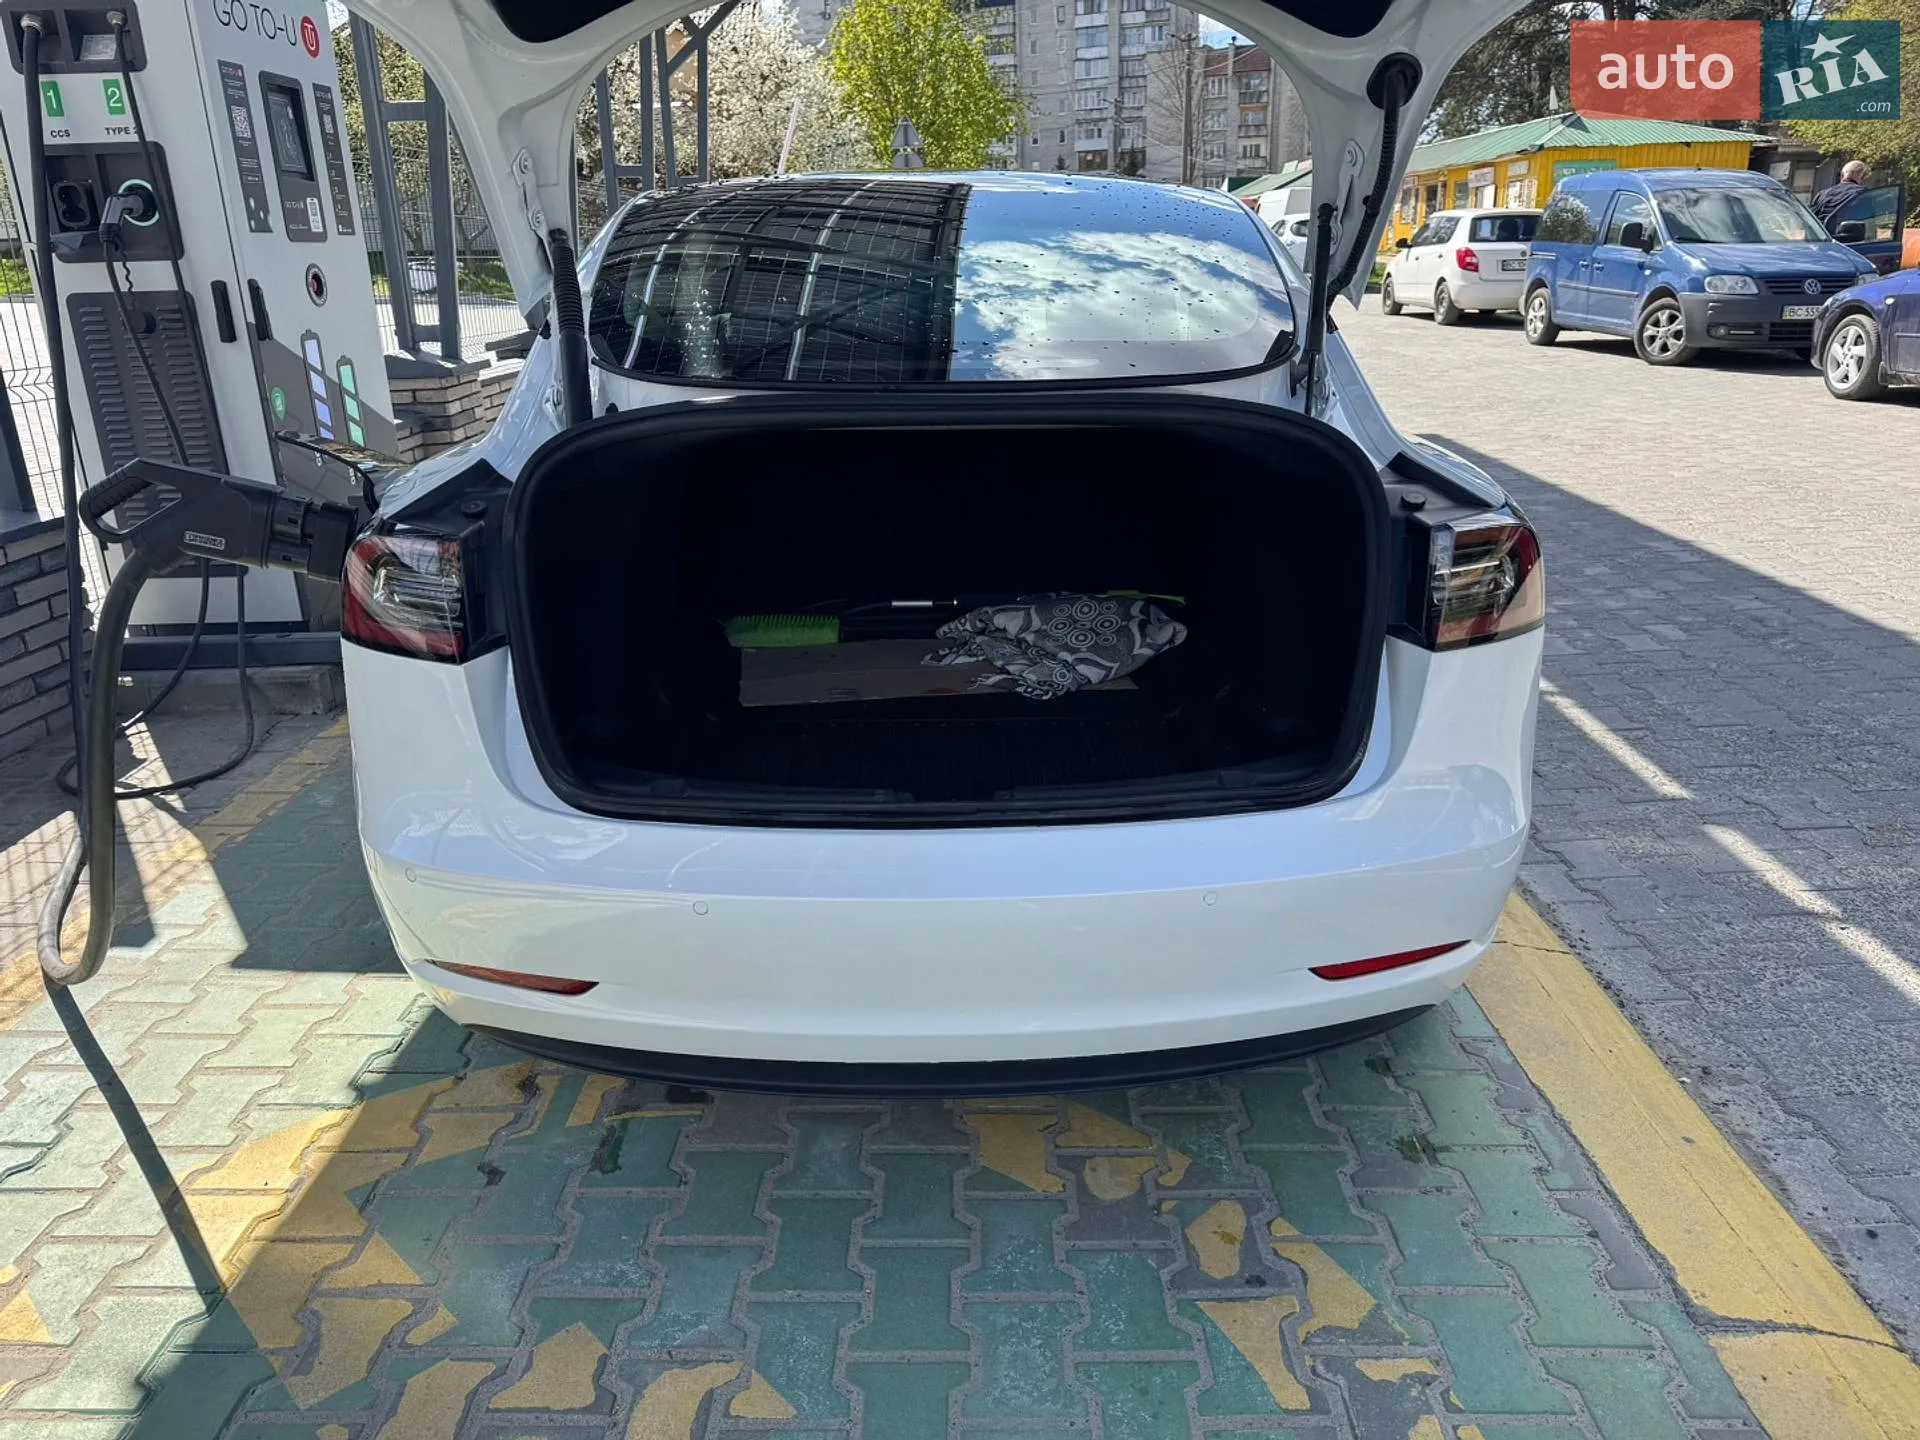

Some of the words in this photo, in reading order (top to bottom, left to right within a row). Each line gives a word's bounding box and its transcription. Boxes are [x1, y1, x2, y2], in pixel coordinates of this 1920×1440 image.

[213, 0, 248, 31] GO
[249, 3, 298, 46] TO-U
[46, 88, 57, 109] 1
[107, 87, 122, 107] 2
[50, 129, 71, 138] CCS
[104, 126, 131, 136] TYPE
